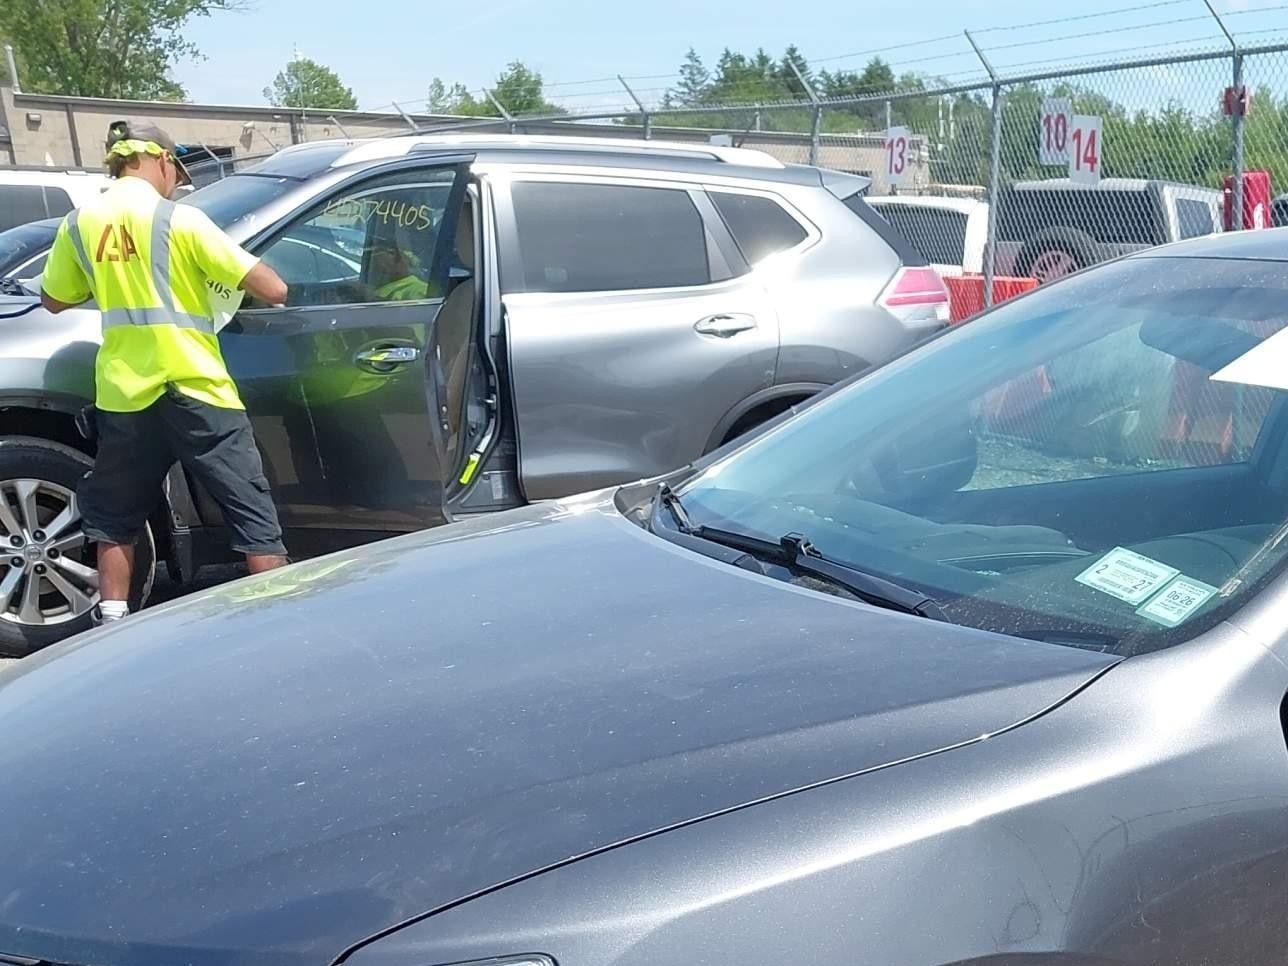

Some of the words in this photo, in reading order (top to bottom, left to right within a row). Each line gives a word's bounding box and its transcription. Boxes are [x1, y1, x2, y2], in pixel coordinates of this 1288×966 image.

[1043, 113, 1066, 152] 10
[1072, 128, 1098, 173] 14
[884, 136, 906, 175] 13
[1095, 564, 1109, 575] 2
[1132, 579, 1154, 592] 27
